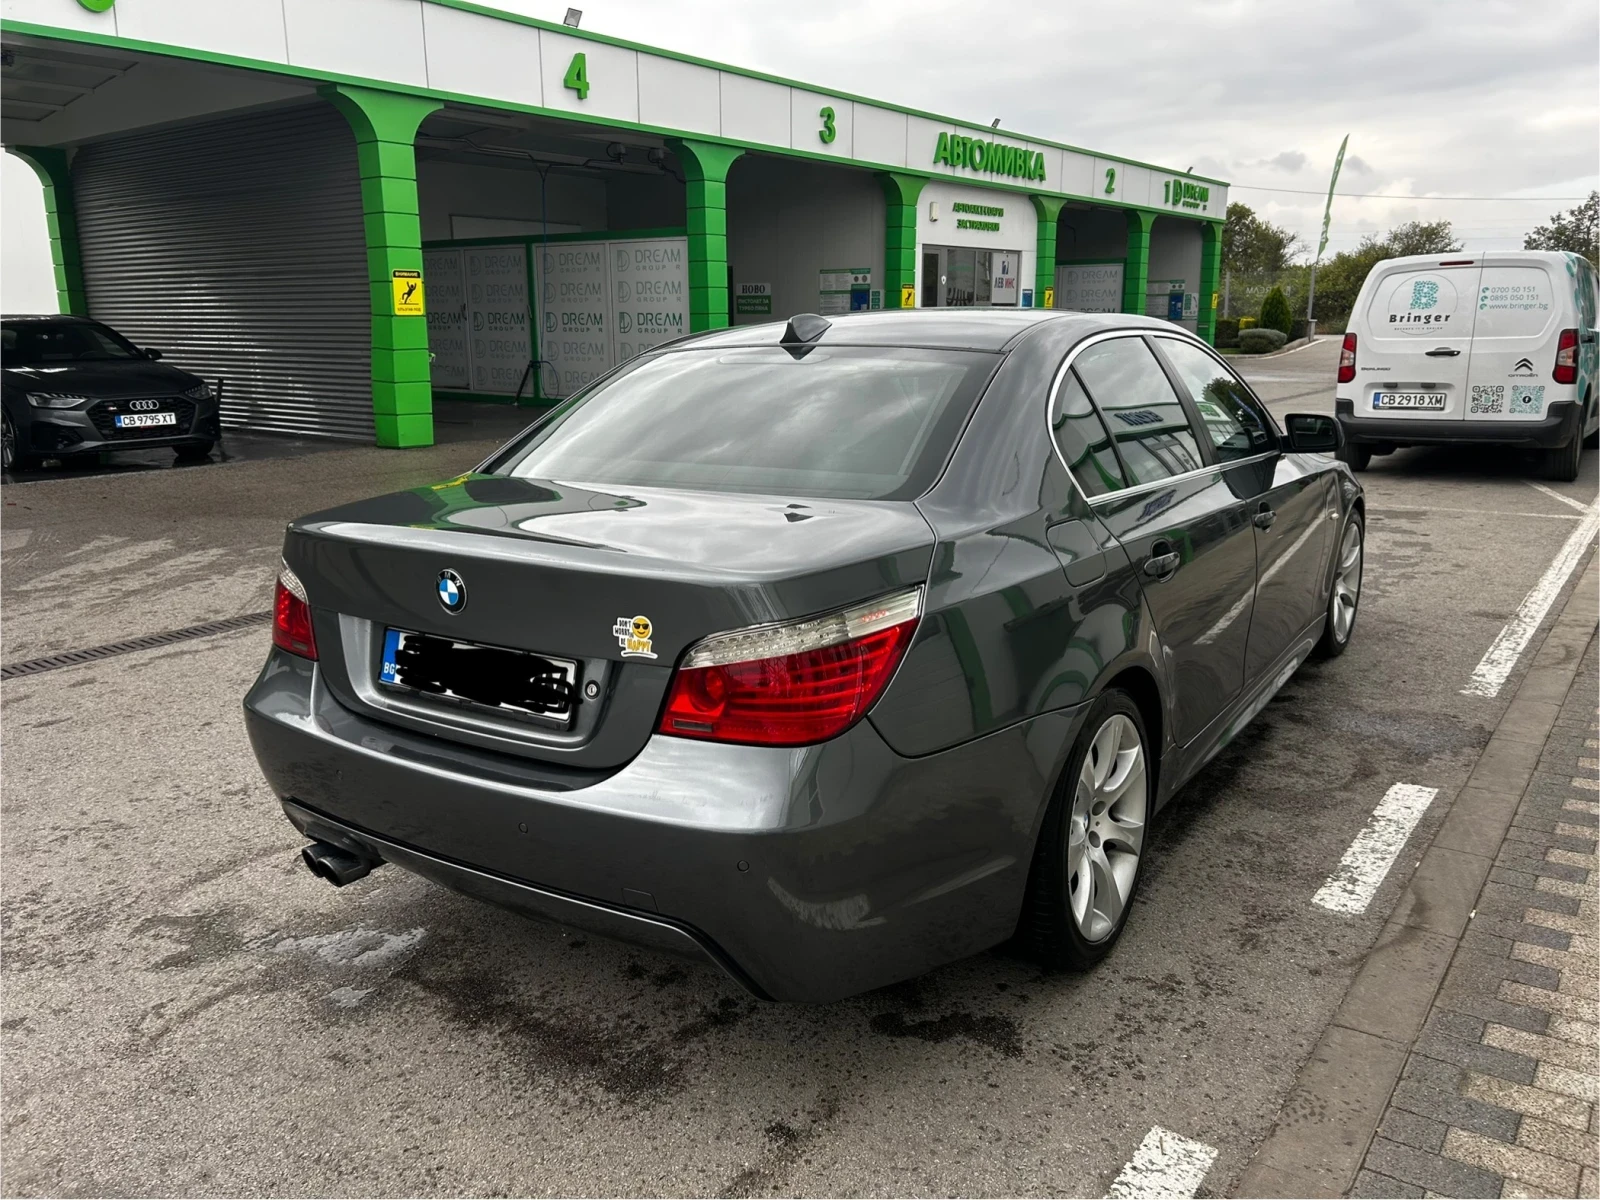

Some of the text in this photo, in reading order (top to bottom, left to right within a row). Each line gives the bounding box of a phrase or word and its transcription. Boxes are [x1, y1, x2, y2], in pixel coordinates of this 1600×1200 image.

[563, 52, 590, 100] 4
[819, 106, 837, 144] 3
[933, 131, 1047, 182] АВТОМИВКА
[1104, 167, 1116, 194] 2
[1164, 180, 1171, 204] 1
[1183, 182, 1209, 203] DREAM
[559, 252, 600, 266] DREAM
[635, 248, 681, 263] DREAM
[1082, 270, 1118, 279] DREAM
[560, 282, 602, 296] DREAM
[636, 280, 682, 295] DREAM
[742, 284, 765, 294] НОВО
[1081, 289, 1117, 298] DREAM
[428, 312, 461, 324] DREAM
[488, 312, 525, 325] DREAM
[562, 312, 603, 326] DREAM
[637, 312, 683, 327] DREAM
[1389, 312, 1450, 324] Bringer
[563, 342, 604, 355] DREAM
[1381, 395, 1443, 405] CB 2918 XM
[123, 414, 173, 425] CB 9795 XT
[383, 662, 395, 675] BG
